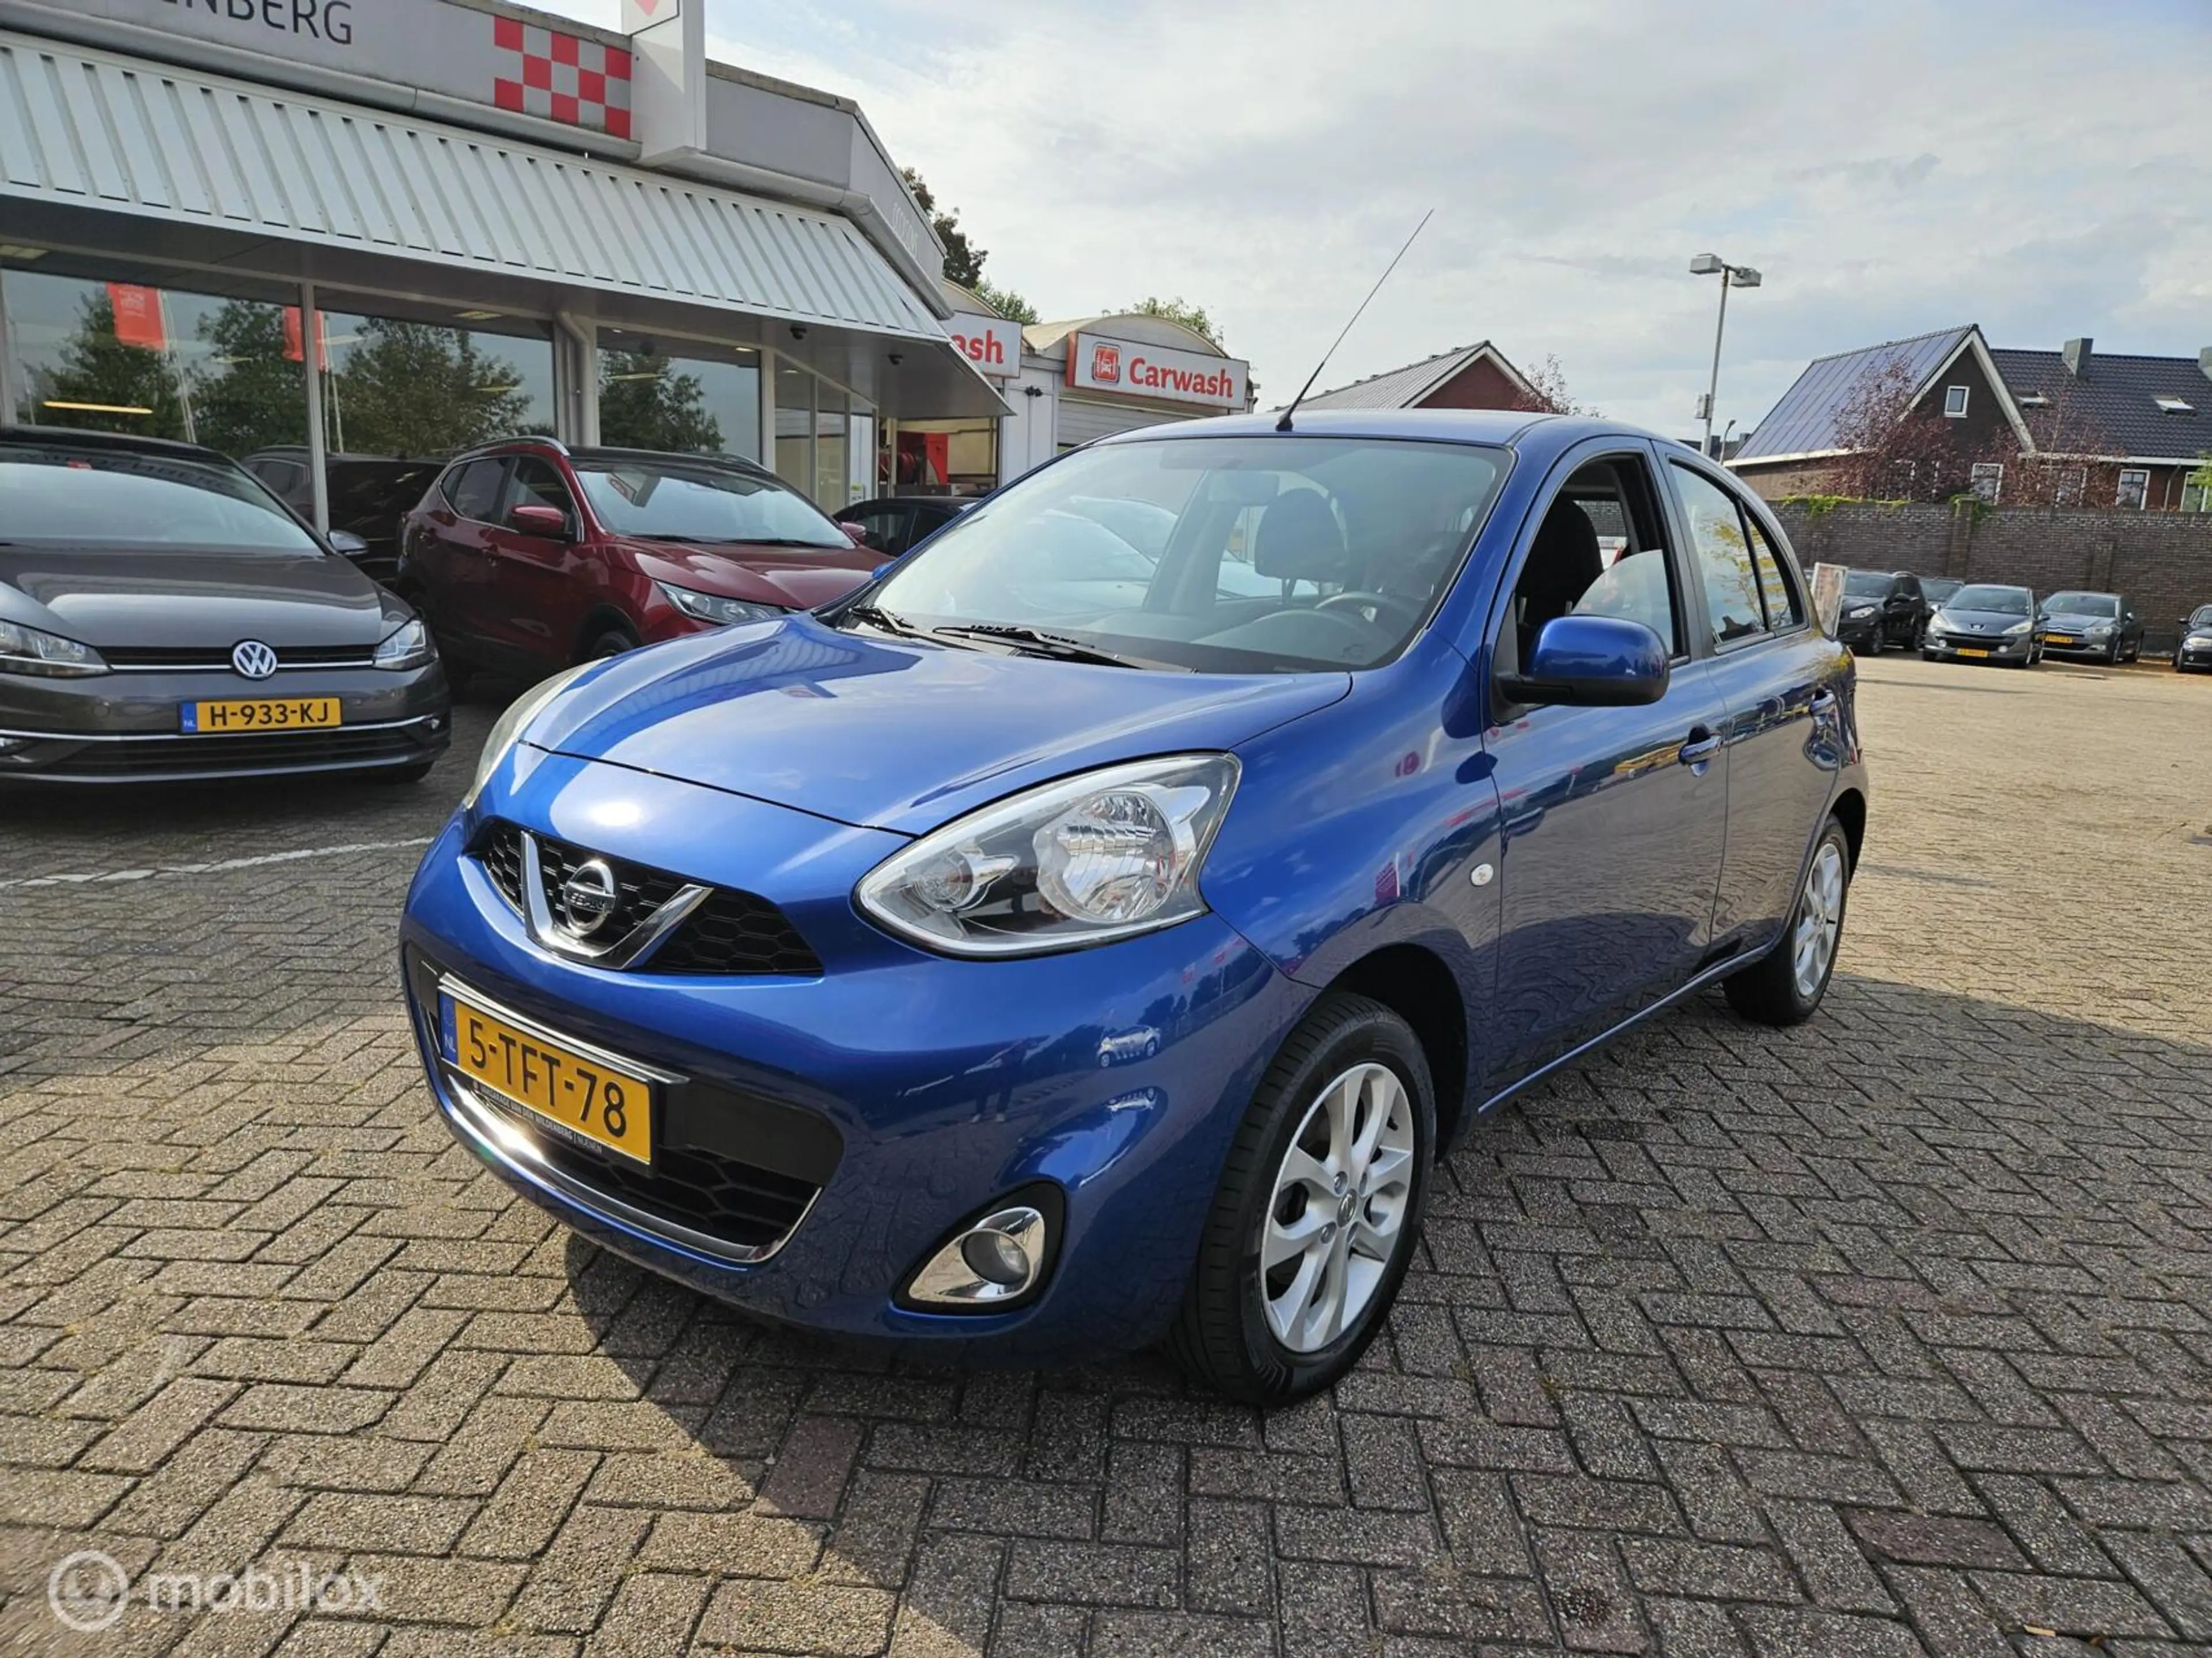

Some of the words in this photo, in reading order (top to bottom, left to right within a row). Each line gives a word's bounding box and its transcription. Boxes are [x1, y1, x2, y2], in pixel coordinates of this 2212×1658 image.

[1130, 357, 1233, 397] Carwash
[210, 702, 328, 726] H-933-KJ
[444, 1033, 456, 1053] NL
[469, 1016, 627, 1138] 5-TFT-78
